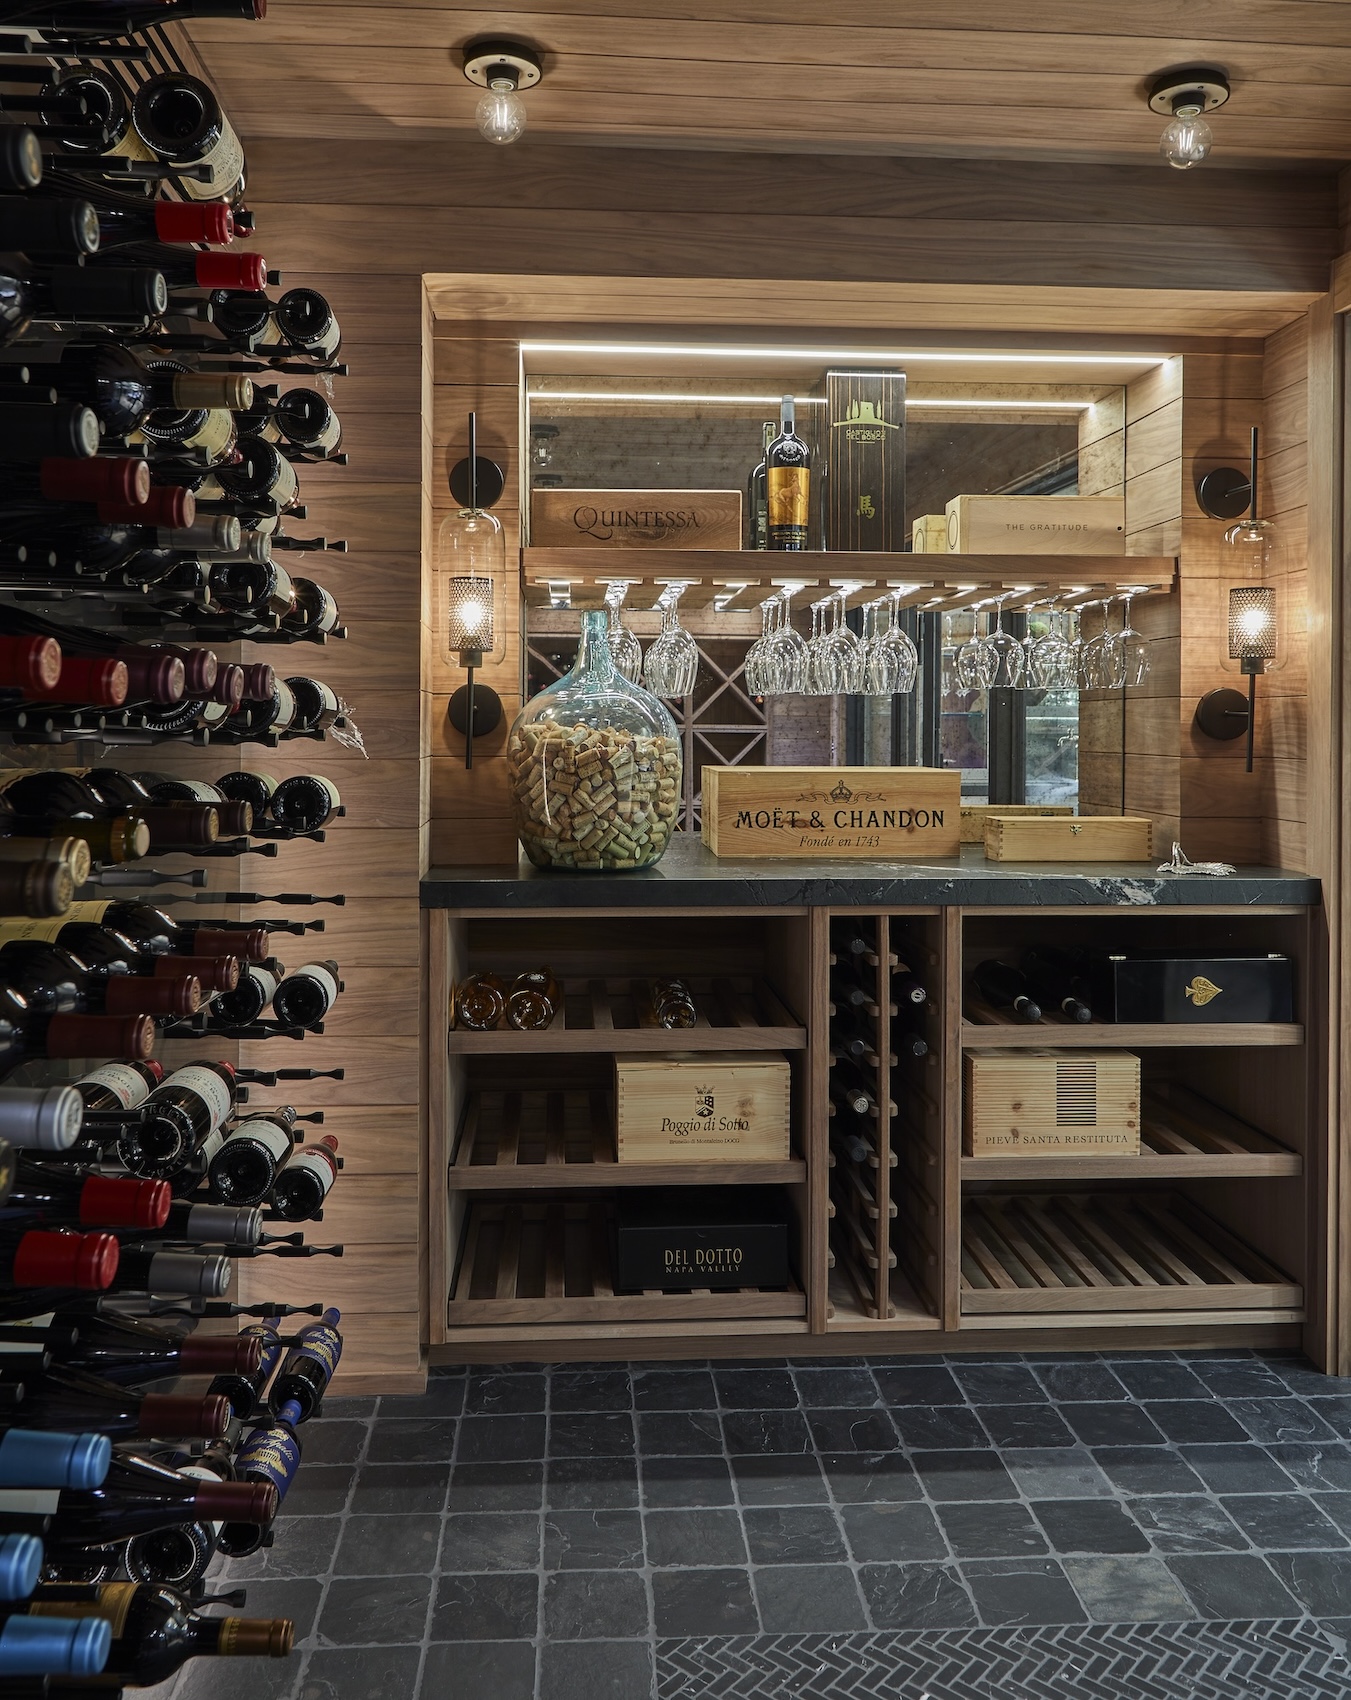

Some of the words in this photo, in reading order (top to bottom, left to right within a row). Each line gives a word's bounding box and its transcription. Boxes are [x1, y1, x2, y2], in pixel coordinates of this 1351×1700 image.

[856, 495, 876, 519] 馬
[573, 505, 701, 541] QUINTESSA
[1006, 523, 1025, 531] THE
[1029, 523, 1089, 531] GRATITUDE
[735, 808, 801, 829] MOËT
[809, 810, 825, 829] &
[833, 809, 945, 829] CHANDON
[799, 835, 835, 848] Fondé
[838, 838, 852, 847] en
[856, 835, 881, 848] 1743
[661, 1118, 701, 1136] Poggio
[703, 1117, 716, 1131] di
[719, 1116, 750, 1131] Sotto
[985, 1135, 1020, 1145] PIEVE
[1023, 1135, 1061, 1144] SANTA
[1065, 1134, 1129, 1144] RESTITUTA
[664, 1249, 689, 1265] DEL
[696, 1248, 742, 1264] DOTTO
